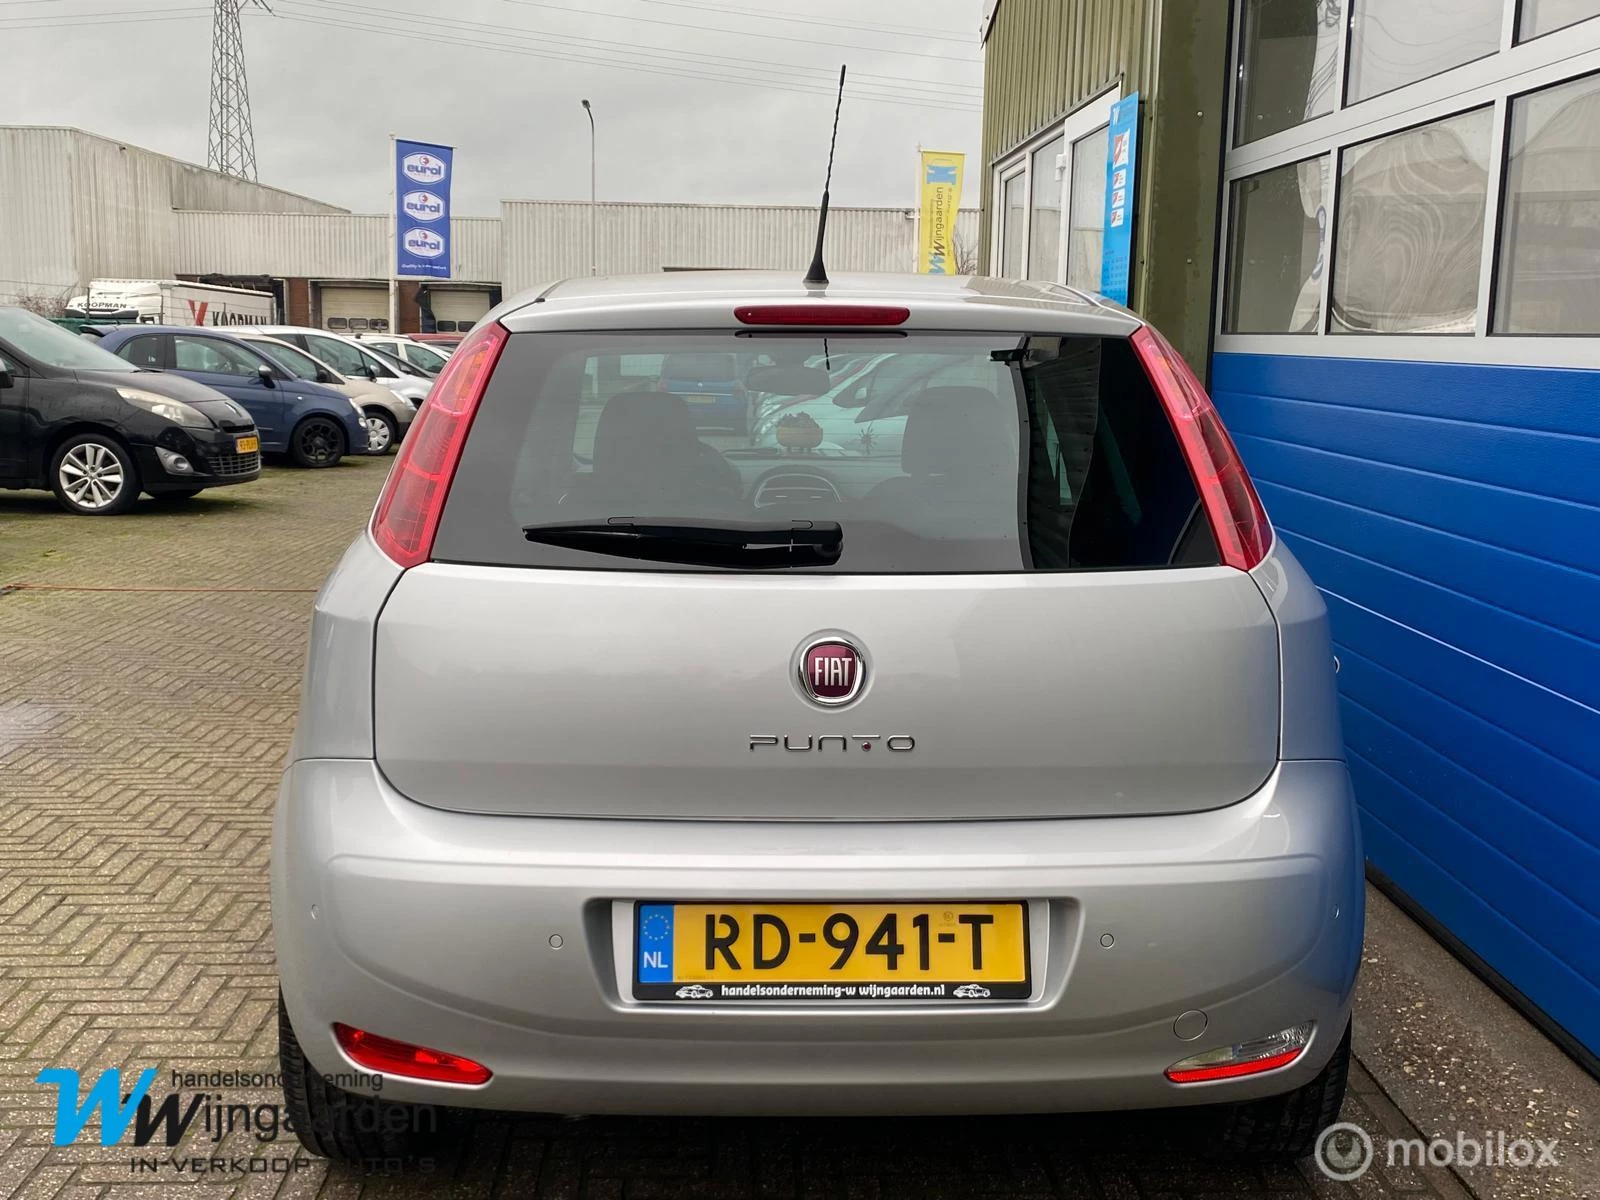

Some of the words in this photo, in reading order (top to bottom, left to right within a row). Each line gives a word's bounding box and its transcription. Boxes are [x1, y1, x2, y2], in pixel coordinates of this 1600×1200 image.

[407, 164, 442, 176] eurol
[406, 201, 440, 213] eurol
[408, 239, 441, 251] eurol
[814, 657, 852, 686] FIAT
[749, 734, 916, 753] PUNTO
[643, 951, 668, 969] NL
[705, 913, 994, 971] RD-941-T
[721, 983, 856, 998] handelsonderneming-w
[858, 984, 946, 998] wijngaarden.nl
